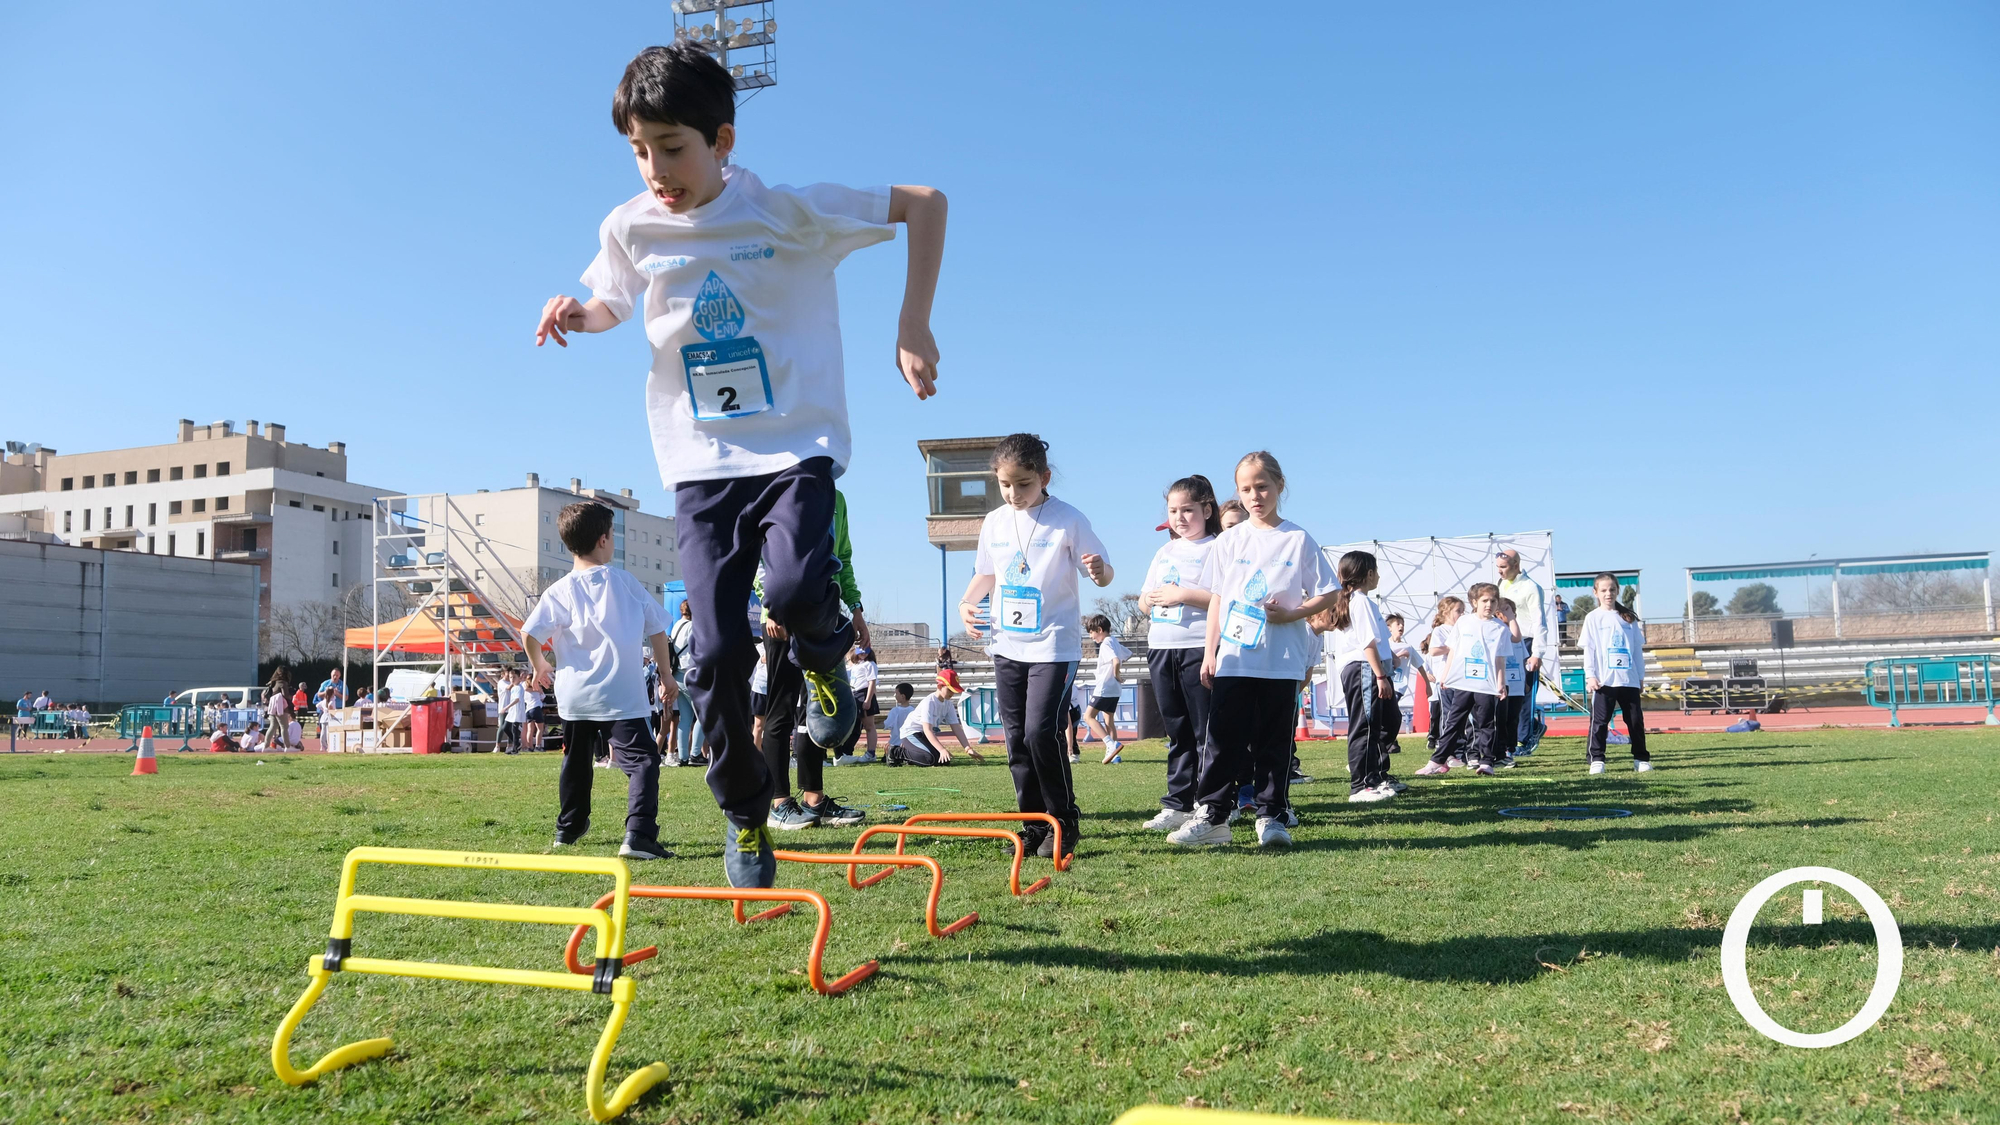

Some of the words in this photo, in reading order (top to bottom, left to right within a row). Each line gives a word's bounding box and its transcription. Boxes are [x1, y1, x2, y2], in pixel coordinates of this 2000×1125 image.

[731, 248, 763, 261] unicef
[644, 258, 678, 271] EMACSA
[700, 277, 728, 299] CADA
[700, 297, 741, 320] GOTA
[687, 350, 710, 360] EMACSA
[728, 347, 751, 359] unicef
[717, 386, 741, 412] 2
[1012, 611, 1023, 625] 2
[1233, 625, 1243, 639] 2
[1616, 658, 1623, 666] 2
[464, 856, 499, 865] KIPSTA
